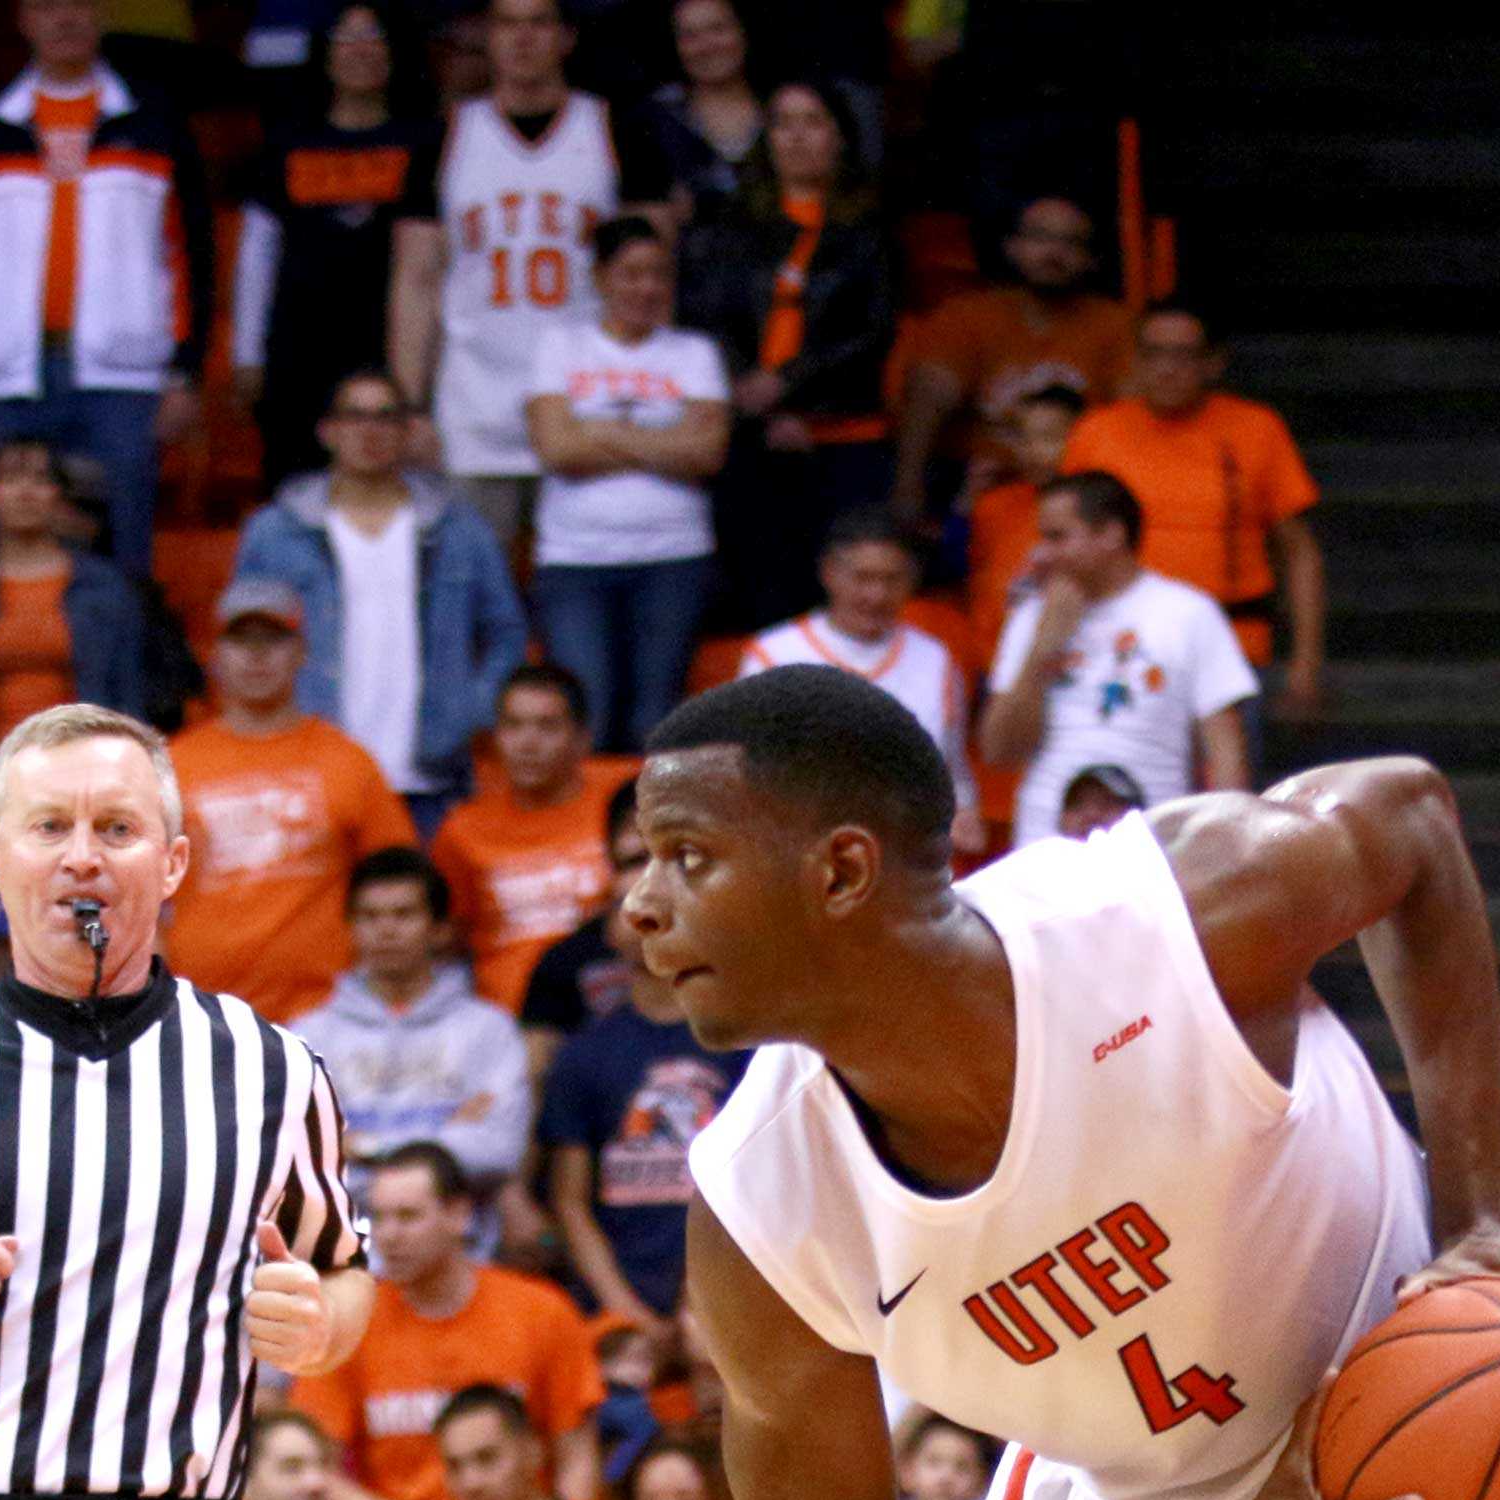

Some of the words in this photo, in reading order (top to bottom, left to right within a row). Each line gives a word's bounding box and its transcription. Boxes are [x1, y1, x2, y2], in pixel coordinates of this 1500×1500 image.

[491, 247, 568, 309] 10
[961, 1200, 1172, 1366] UTEP
[1116, 1332, 1247, 1435] 4
